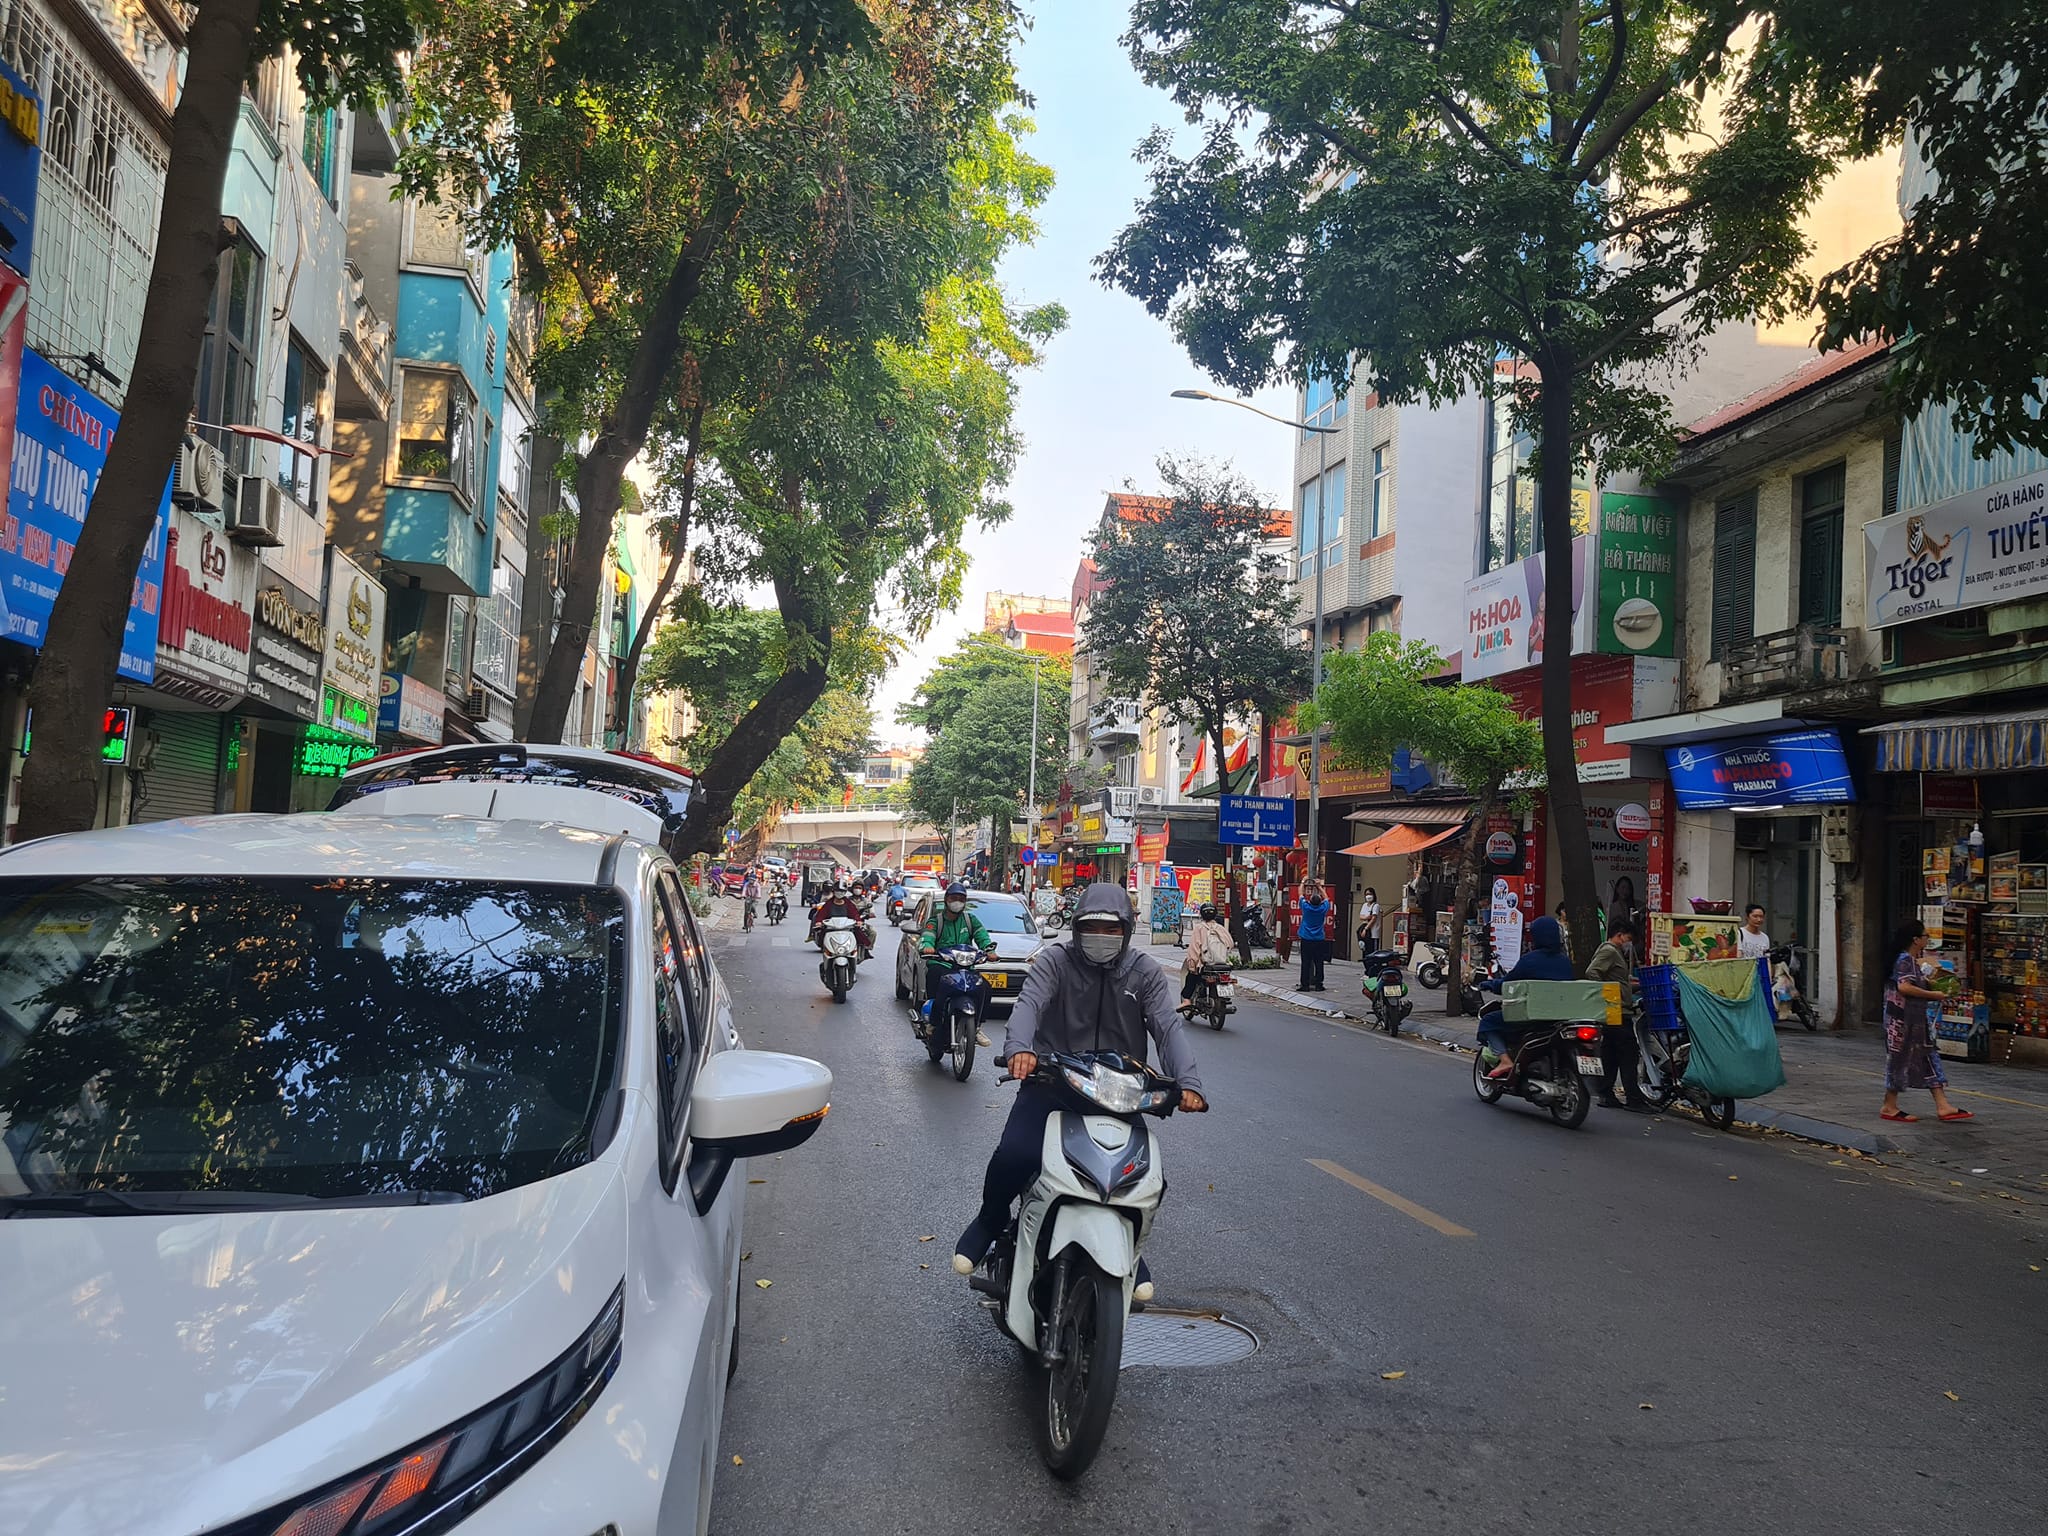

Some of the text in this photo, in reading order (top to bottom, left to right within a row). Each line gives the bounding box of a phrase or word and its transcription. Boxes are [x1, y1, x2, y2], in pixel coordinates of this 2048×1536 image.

[39, 384, 103, 450] CHÍNH
[45, 444, 89, 521] TÙNG
[1986, 482, 2044, 514] CỬA HÀNG
[1605, 504, 1672, 540] NẤM VIỆT
[1987, 506, 2048, 559] TUYẾT
[1604, 543, 1671, 574] HÀ THÀNH
[1965, 576, 1977, 585] BIA
[2018, 561, 2035, 574] NGỌT
[1885, 552, 1954, 599] Tiger
[1897, 598, 1944, 617] CRYSTAL
[1725, 750, 1771, 767] NHÀ THUỐC
[1733, 779, 1777, 792] PHARMACY
[1244, 800, 1265, 810] THANH
[1266, 800, 1284, 811] NHÀN
[1609, 842, 1639, 855] PHỤC
